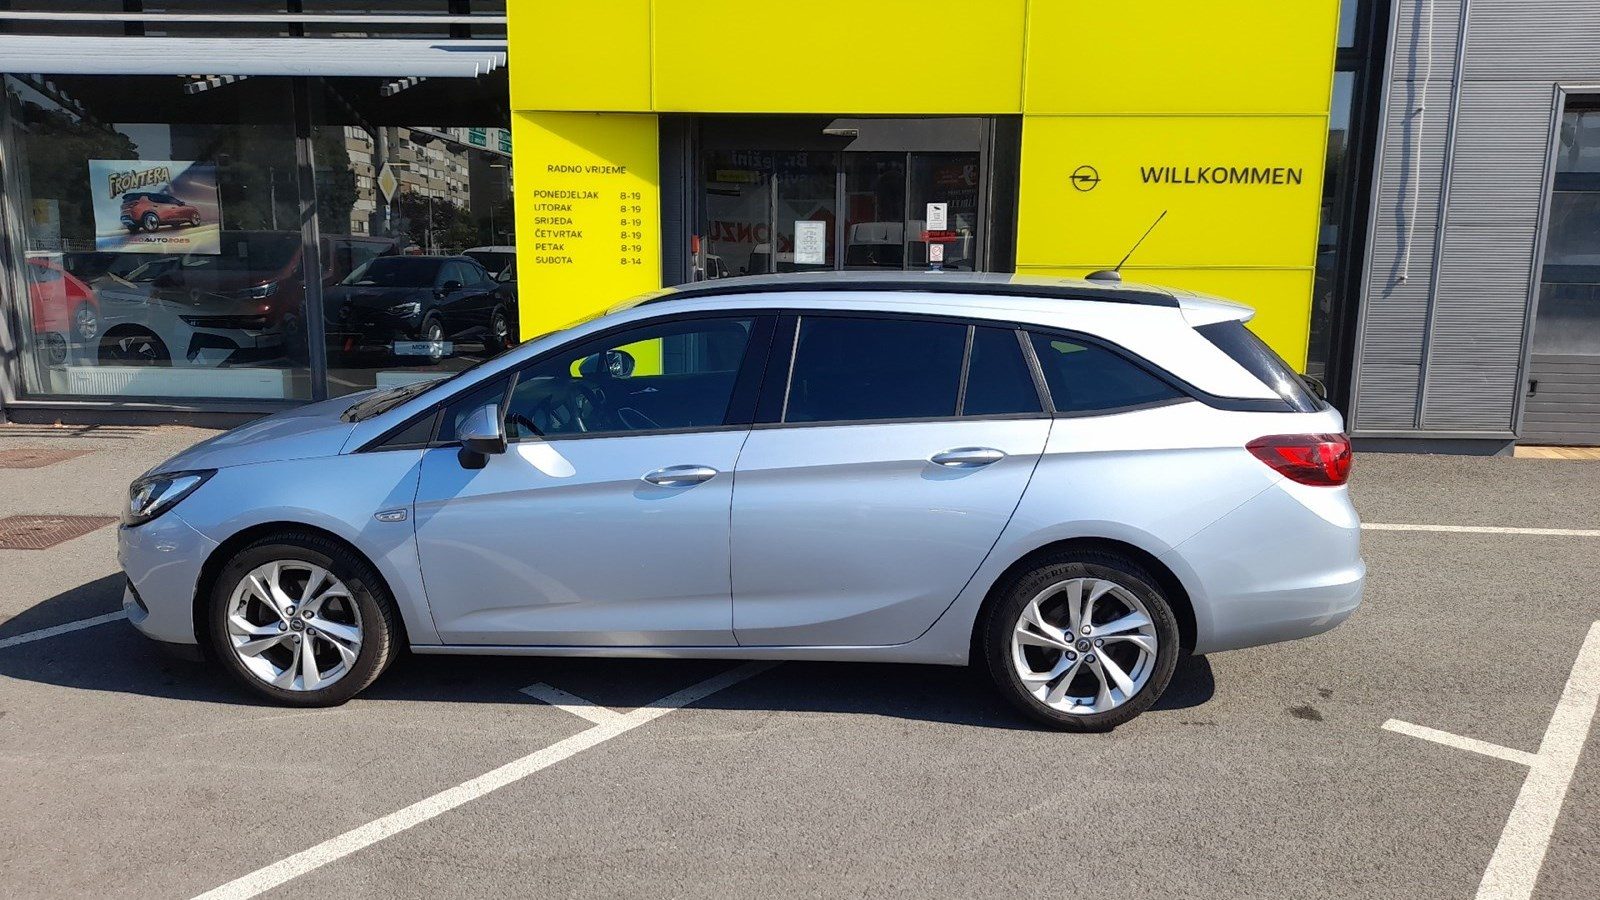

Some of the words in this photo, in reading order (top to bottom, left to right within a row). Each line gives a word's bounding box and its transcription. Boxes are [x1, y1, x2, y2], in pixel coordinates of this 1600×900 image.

[547, 164, 583, 174] RADNO
[585, 165, 627, 175] VRIJEME
[1140, 166, 1302, 185] WILLKOMMEN
[108, 166, 171, 199] FRONTERA
[533, 190, 599, 199] PONEDJELJAK
[620, 192, 641, 200] 8-19
[534, 203, 573, 212] UTORAK
[620, 205, 641, 213] 8-19
[534, 216, 573, 225] SRIJEDA
[620, 218, 642, 227] 8-19
[534, 229, 583, 238] ČETVRTAK
[620, 231, 642, 239] 8-19
[535, 243, 565, 251] PETAK
[620, 244, 642, 252] 8-19
[536, 256, 573, 264] SUBOTA
[620, 257, 642, 265] 8-14
